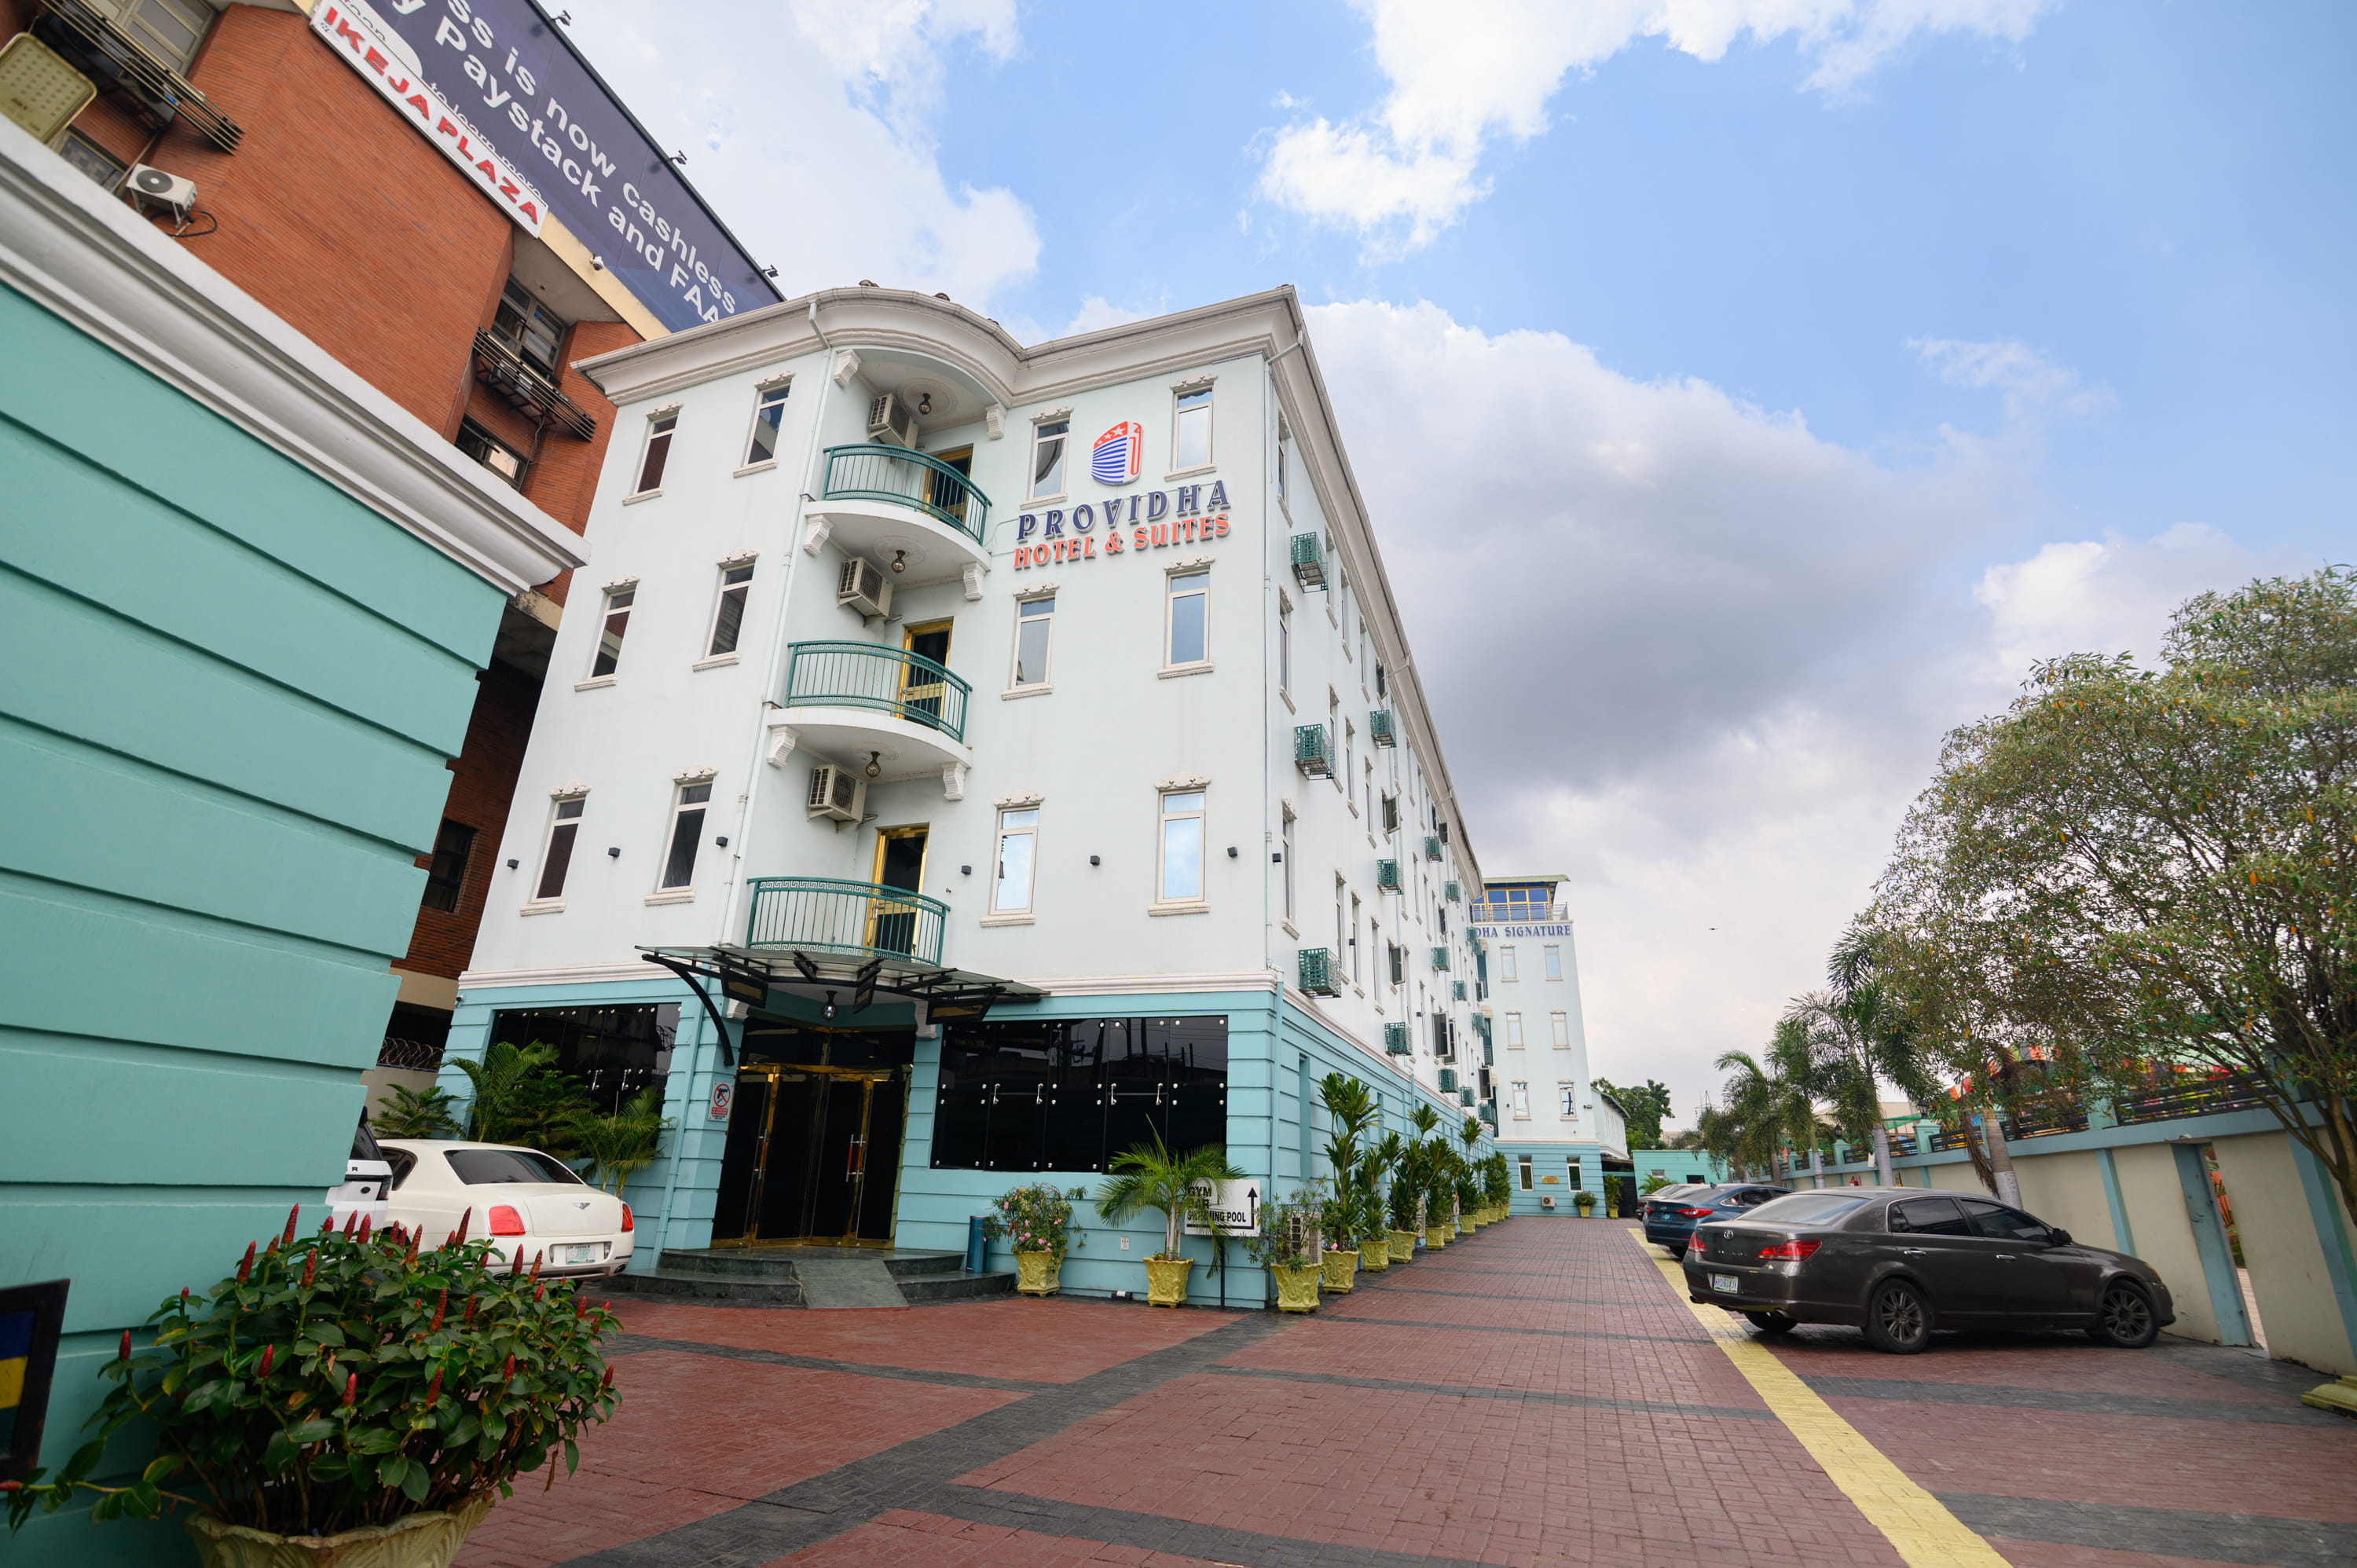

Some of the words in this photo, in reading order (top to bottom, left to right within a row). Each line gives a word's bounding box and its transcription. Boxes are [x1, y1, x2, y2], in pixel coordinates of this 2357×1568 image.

[324, 6, 430, 121] IKEJA
[437, 115, 538, 225] PLAZA
[434, 15, 602, 207] Paystack
[608, 206, 665, 272] and
[504, 46, 536, 96] is
[546, 97, 616, 178] now
[623, 182, 735, 314] cashless
[1017, 480, 1230, 542] PROVIDHA
[1013, 536, 1096, 570] HOTEL
[1105, 531, 1123, 554] &
[1133, 513, 1230, 549] SUITES
[1505, 925, 1571, 937] SIGNATURE
[1188, 1198, 1210, 1209] AR
[1226, 1211, 1246, 1222] POOL
